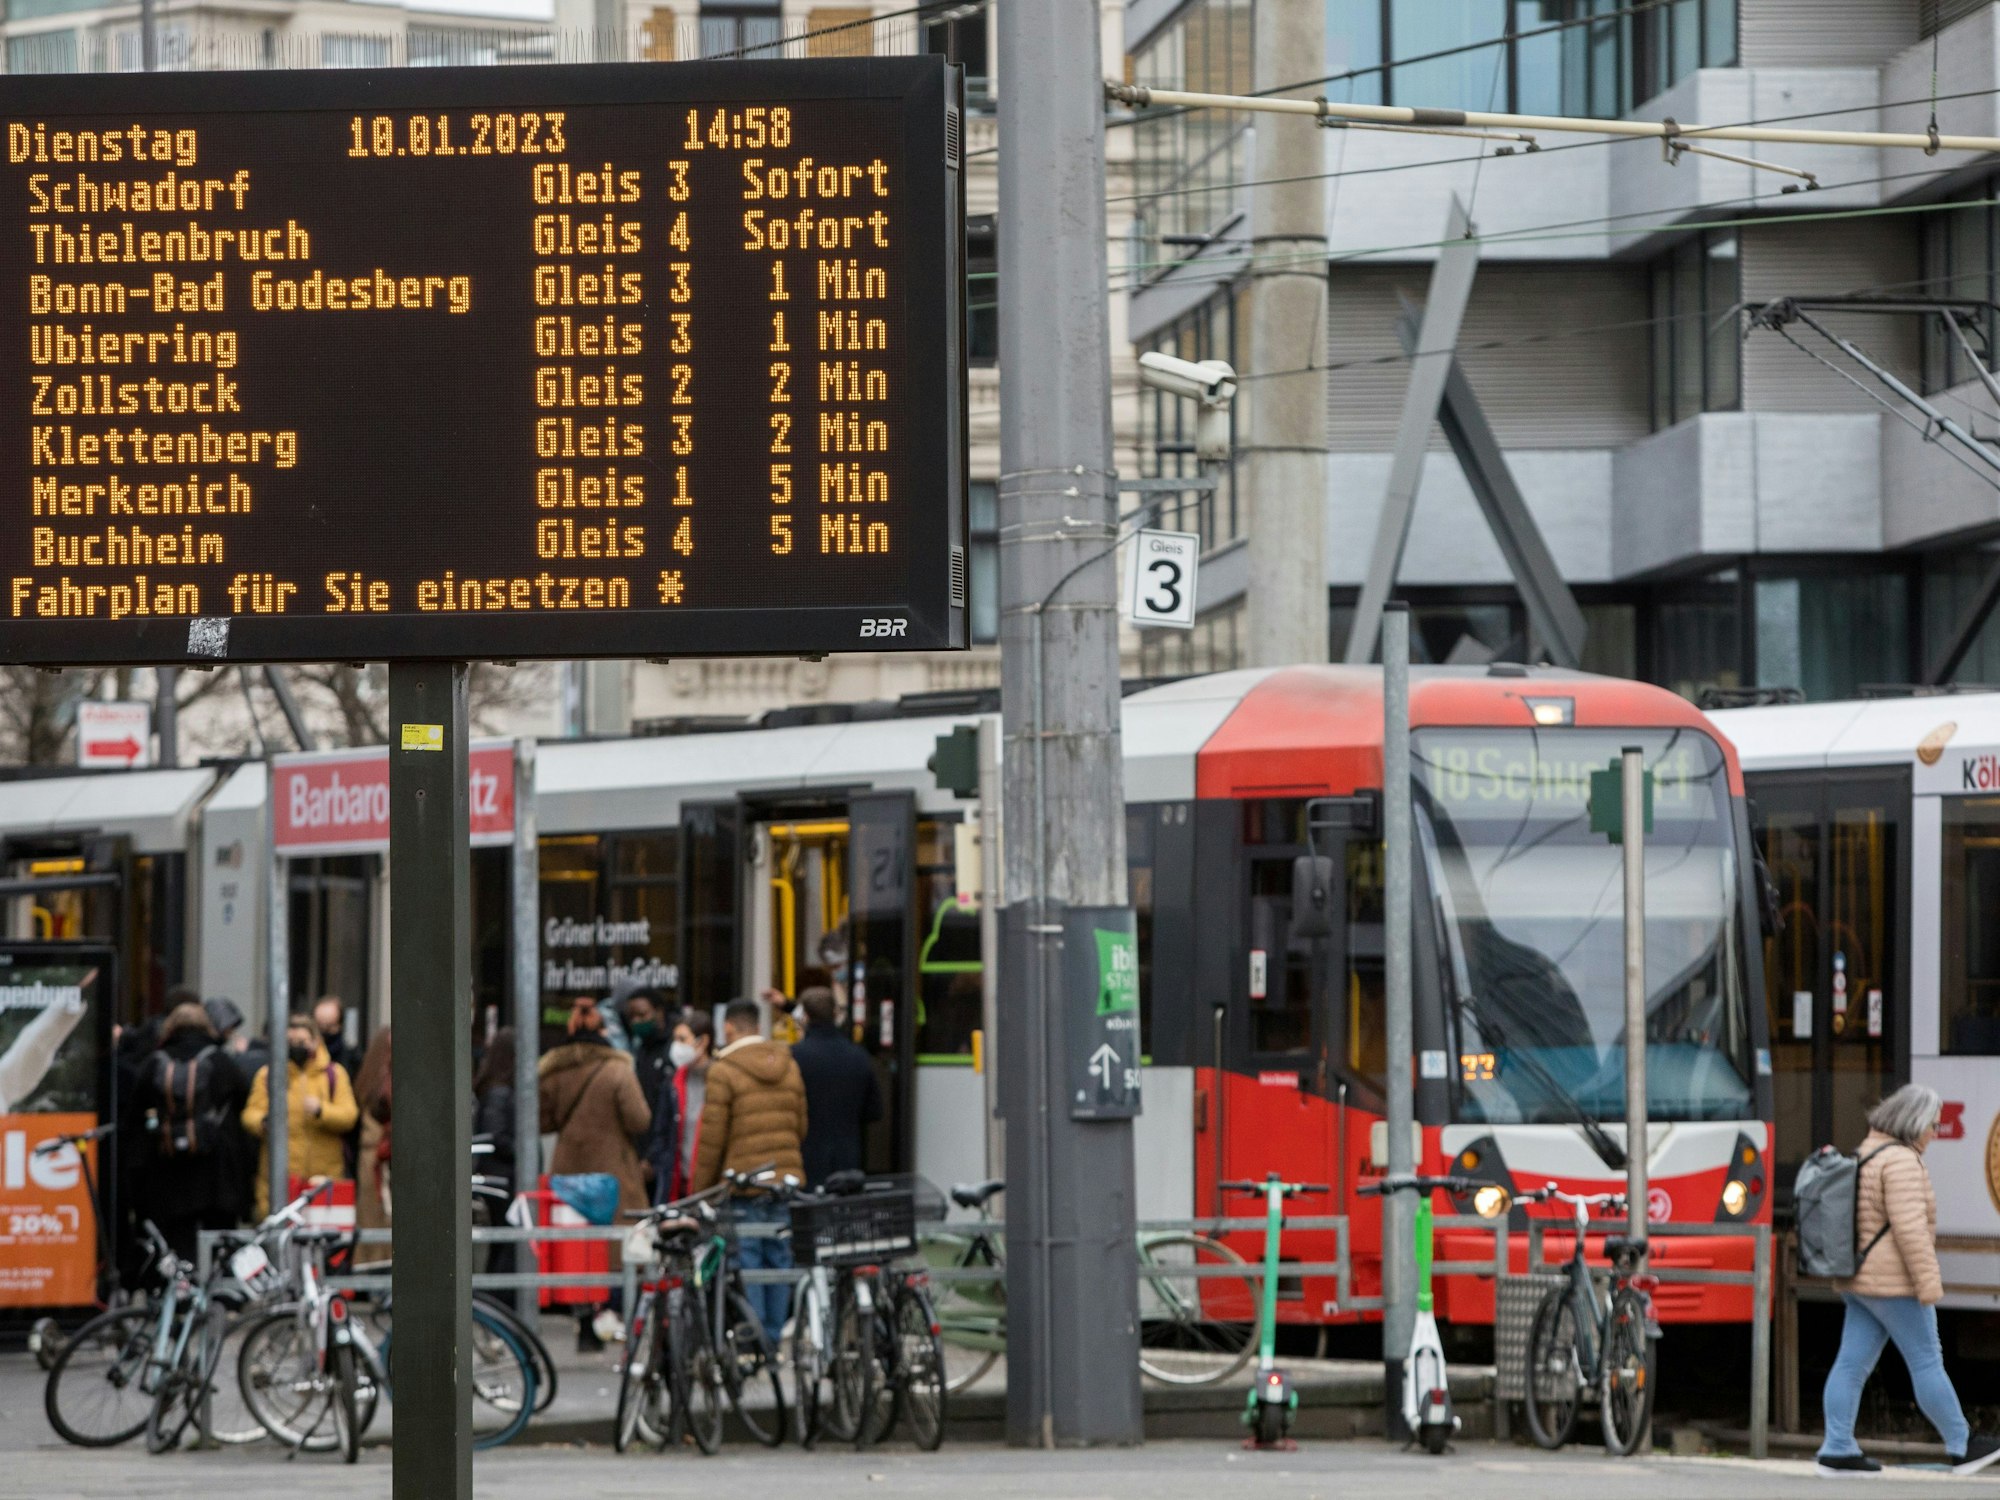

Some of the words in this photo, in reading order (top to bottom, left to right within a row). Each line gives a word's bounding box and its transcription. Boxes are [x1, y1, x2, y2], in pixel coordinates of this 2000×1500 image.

[9, 123, 196, 166] Dienstag
[349, 113, 565, 156] 10.01.2023
[685, 108, 790, 149] 14:58
[30, 170, 249, 213] Schwadorf
[534, 163, 640, 204] Gleis
[670, 161, 689, 201] 3
[744, 158, 887, 199] Sofort
[30, 220, 308, 263] Thielenbruch
[535, 214, 640, 254] Gleis
[670, 212, 689, 251] 4
[744, 209, 887, 250] Sofort
[31, 272, 223, 313] Bonn-Bad
[252, 269, 469, 313] Godesberg
[536, 265, 641, 305] Gleis
[671, 263, 690, 302] 3
[770, 261, 789, 300] 1
[819, 260, 885, 299] Min
[32, 324, 237, 367] Ubierring
[536, 316, 641, 356] Gleis
[671, 314, 690, 353] 3
[770, 312, 789, 351] 1
[820, 311, 885, 350] Min
[32, 373, 240, 414] Zollstock
[537, 366, 642, 406] Gleis
[672, 365, 691, 404] 2
[771, 363, 790, 402] 2
[820, 362, 886, 401] Min
[33, 424, 297, 467] Klettenberg
[538, 417, 642, 457] Gleis
[673, 416, 692, 454] 3
[771, 414, 790, 452] 2
[821, 412, 886, 451] Min
[34, 474, 250, 515] Merkenich
[538, 468, 643, 507] Gleis
[673, 467, 692, 505] 1
[772, 464, 791, 503] 5
[821, 463, 887, 502] Min
[34, 525, 223, 565] Buchheim
[538, 518, 643, 558] Gleis
[674, 517, 692, 555] 4
[772, 515, 791, 554] 5
[822, 514, 887, 553] Min
[1150, 539, 1183, 555] Gleis
[13, 576, 198, 620] Fahrplan
[228, 574, 296, 612] für
[326, 573, 388, 611] Sie
[419, 572, 628, 610] einsetzen
[1145, 560, 1181, 613] 3
[860, 619, 907, 637] BBR
[0, 1130, 81, 1190] le
